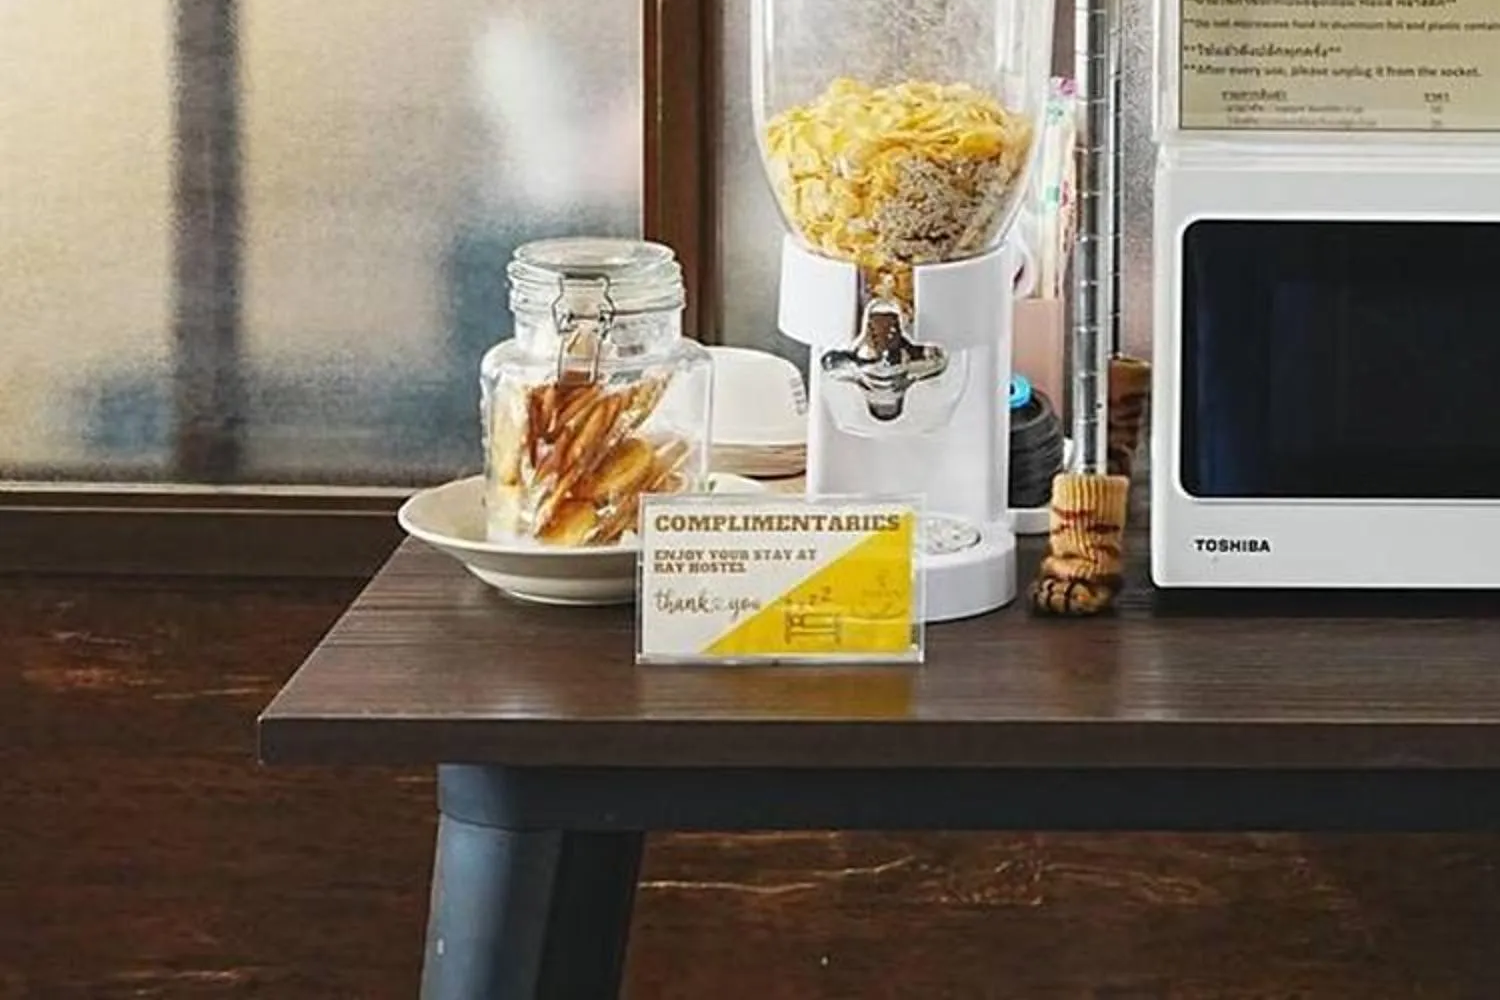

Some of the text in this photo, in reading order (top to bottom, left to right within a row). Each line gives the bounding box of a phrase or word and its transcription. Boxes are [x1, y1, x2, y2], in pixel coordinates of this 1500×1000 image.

[1386, 65, 1414, 77] from
[1418, 66, 1437, 77] the
[654, 514, 901, 533] COMPLIMENTARIES
[1194, 538, 1271, 553] TOSHIBA
[654, 549, 817, 561] ENJOY YOUR STAY AT
[688, 562, 747, 573] HOSTEL
